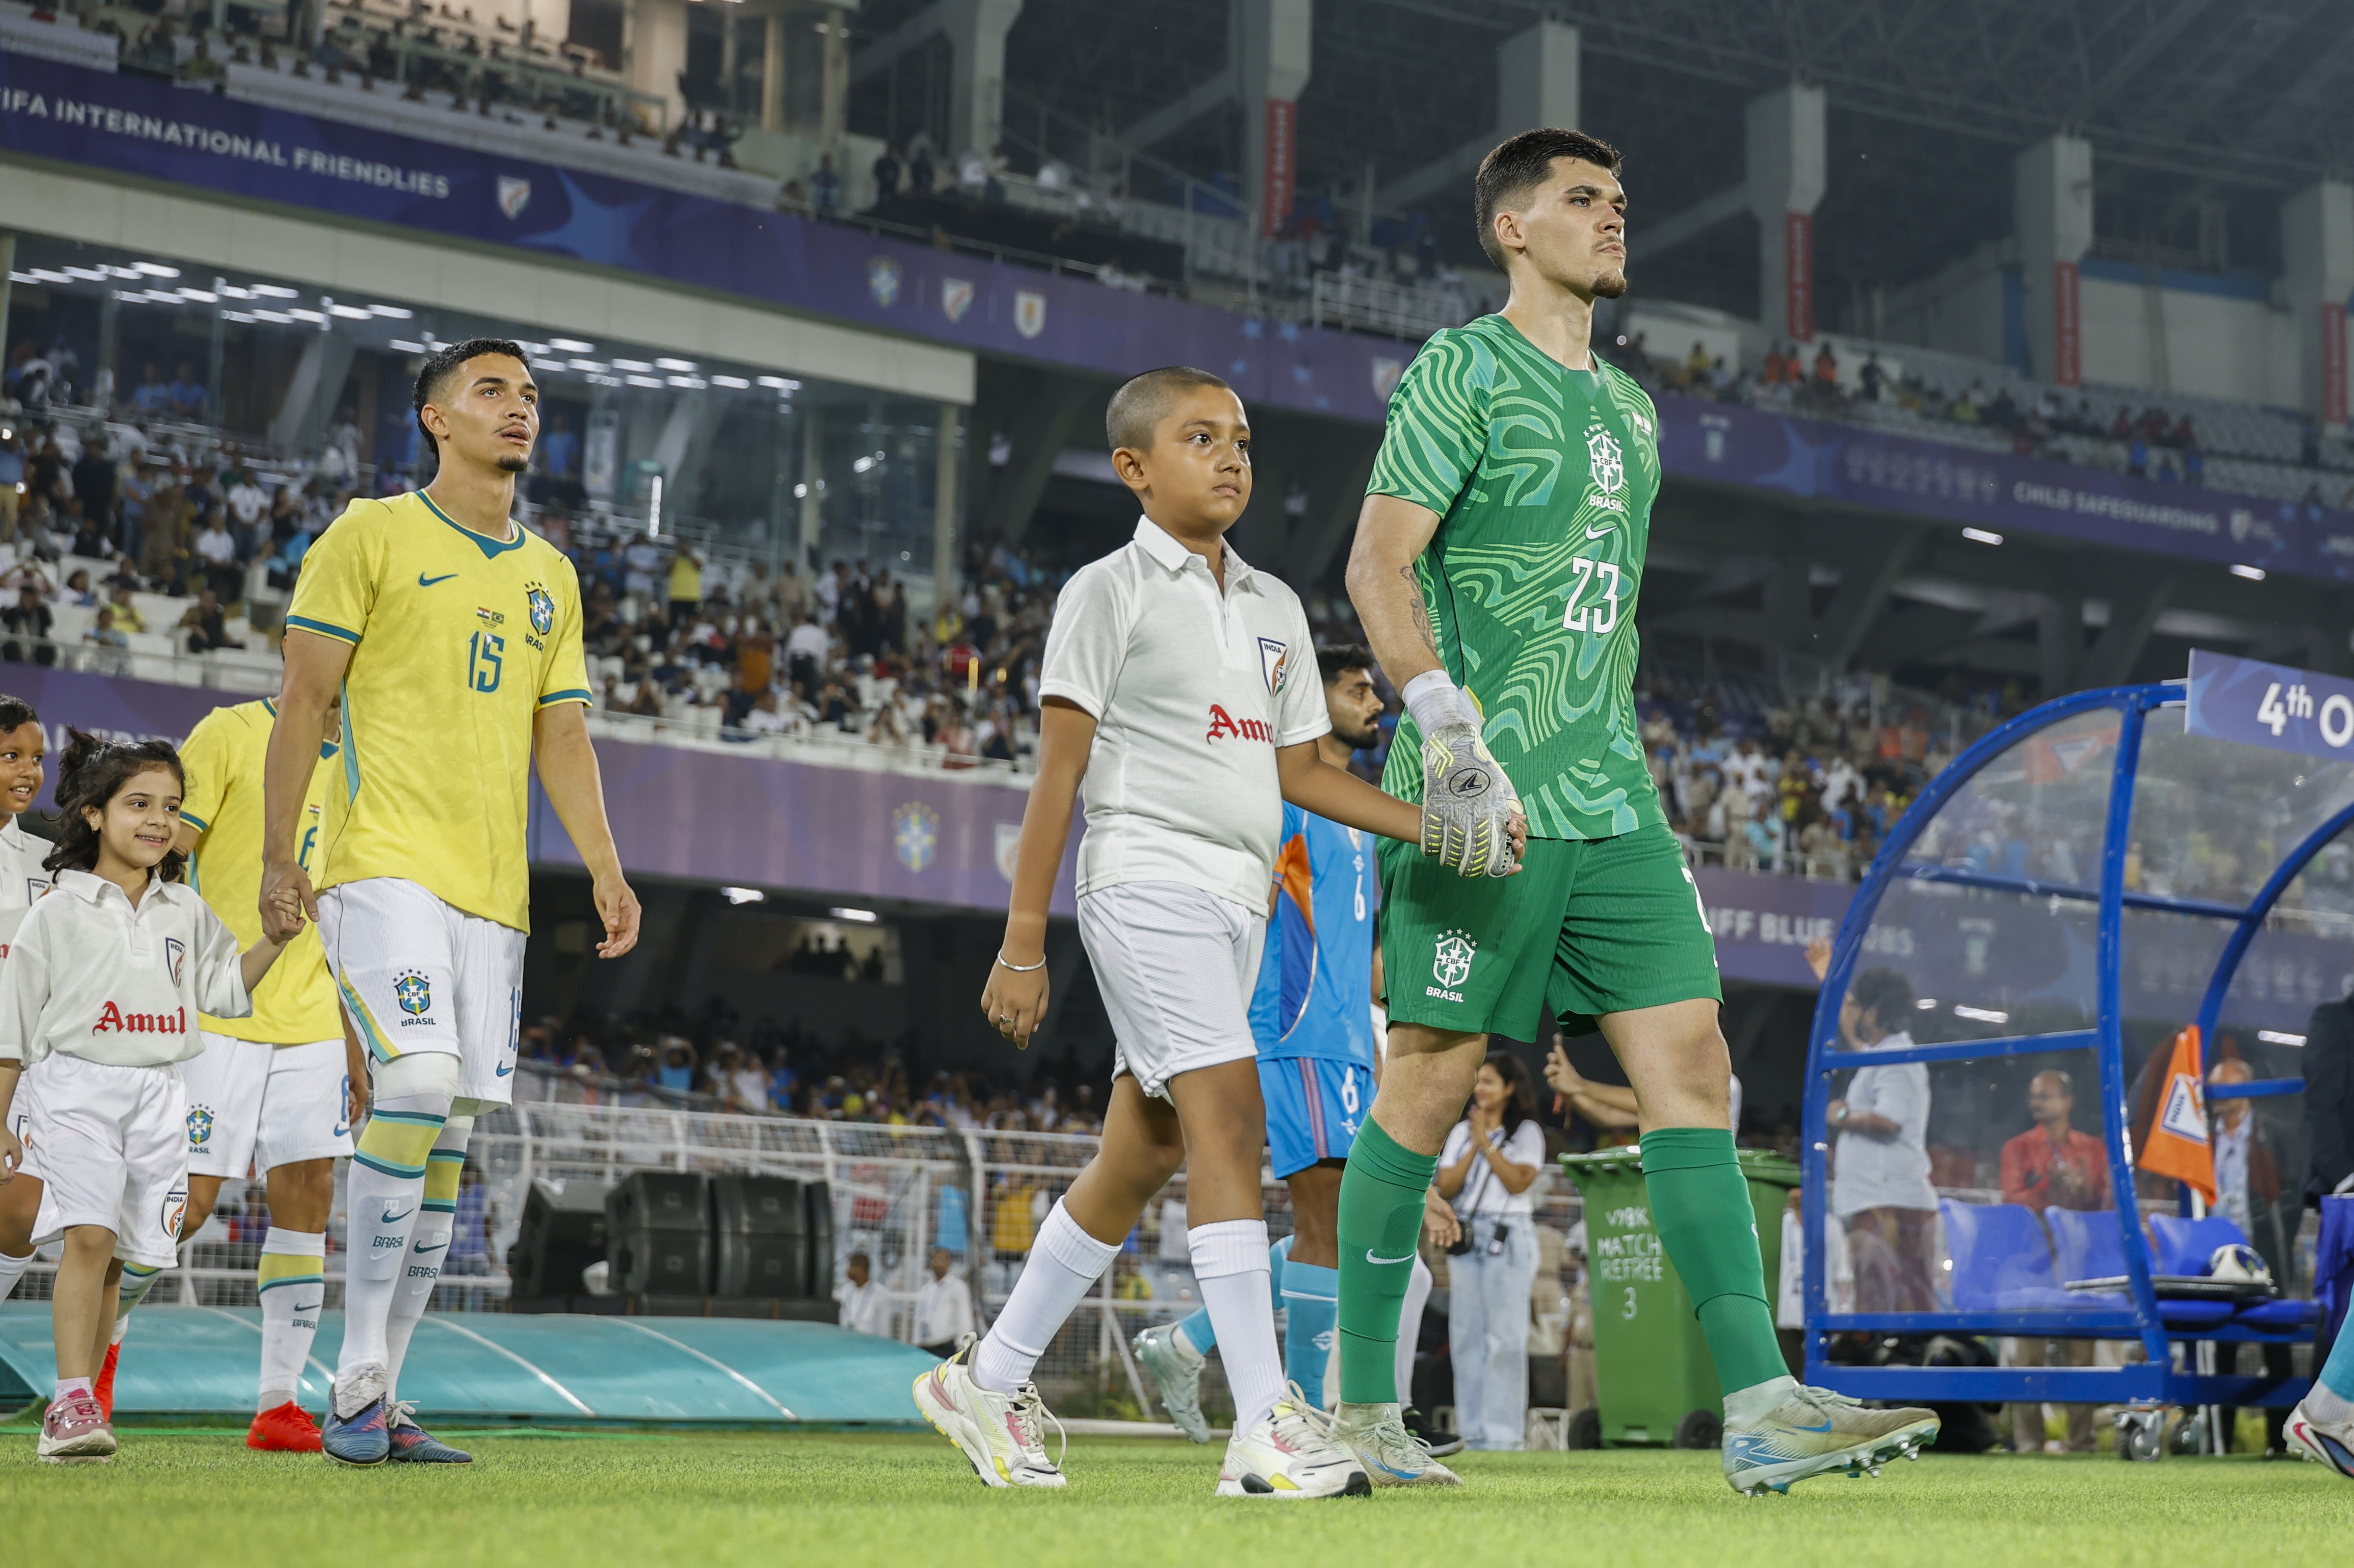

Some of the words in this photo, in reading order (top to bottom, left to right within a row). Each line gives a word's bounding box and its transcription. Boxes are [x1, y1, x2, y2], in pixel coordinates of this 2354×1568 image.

[0, 86, 48, 119] IFA
[55, 97, 288, 167] INTERNATIONAL
[293, 146, 450, 199] FRIENDLIES
[1600, 458, 1612, 466] CBF
[1589, 494, 1624, 513] BRASIL
[2013, 480, 2073, 509] CHILD
[2075, 490, 2219, 536] SAFEGUARDING
[537, 606, 547, 616] CBF
[1562, 555, 1620, 634] 23
[469, 630, 505, 694] 15
[1264, 643, 1282, 655] INDIA
[1206, 704, 1274, 745] Amu
[2257, 682, 2314, 737] 4th
[1354, 874, 1366, 922] 6
[1709, 906, 1754, 941] IFF
[1759, 912, 1835, 947] BLUE
[170, 943, 183, 954] INDIA
[1425, 986, 1464, 1003] BRASIL
[92, 1000, 186, 1037] Amul
[401, 1017, 437, 1026] BRASIL
[1341, 1066, 1360, 1114] 6
[1597, 1233, 1663, 1258] MATCH
[1600, 1256, 1664, 1282] REFREE
[1621, 1286, 1638, 1321] 3
